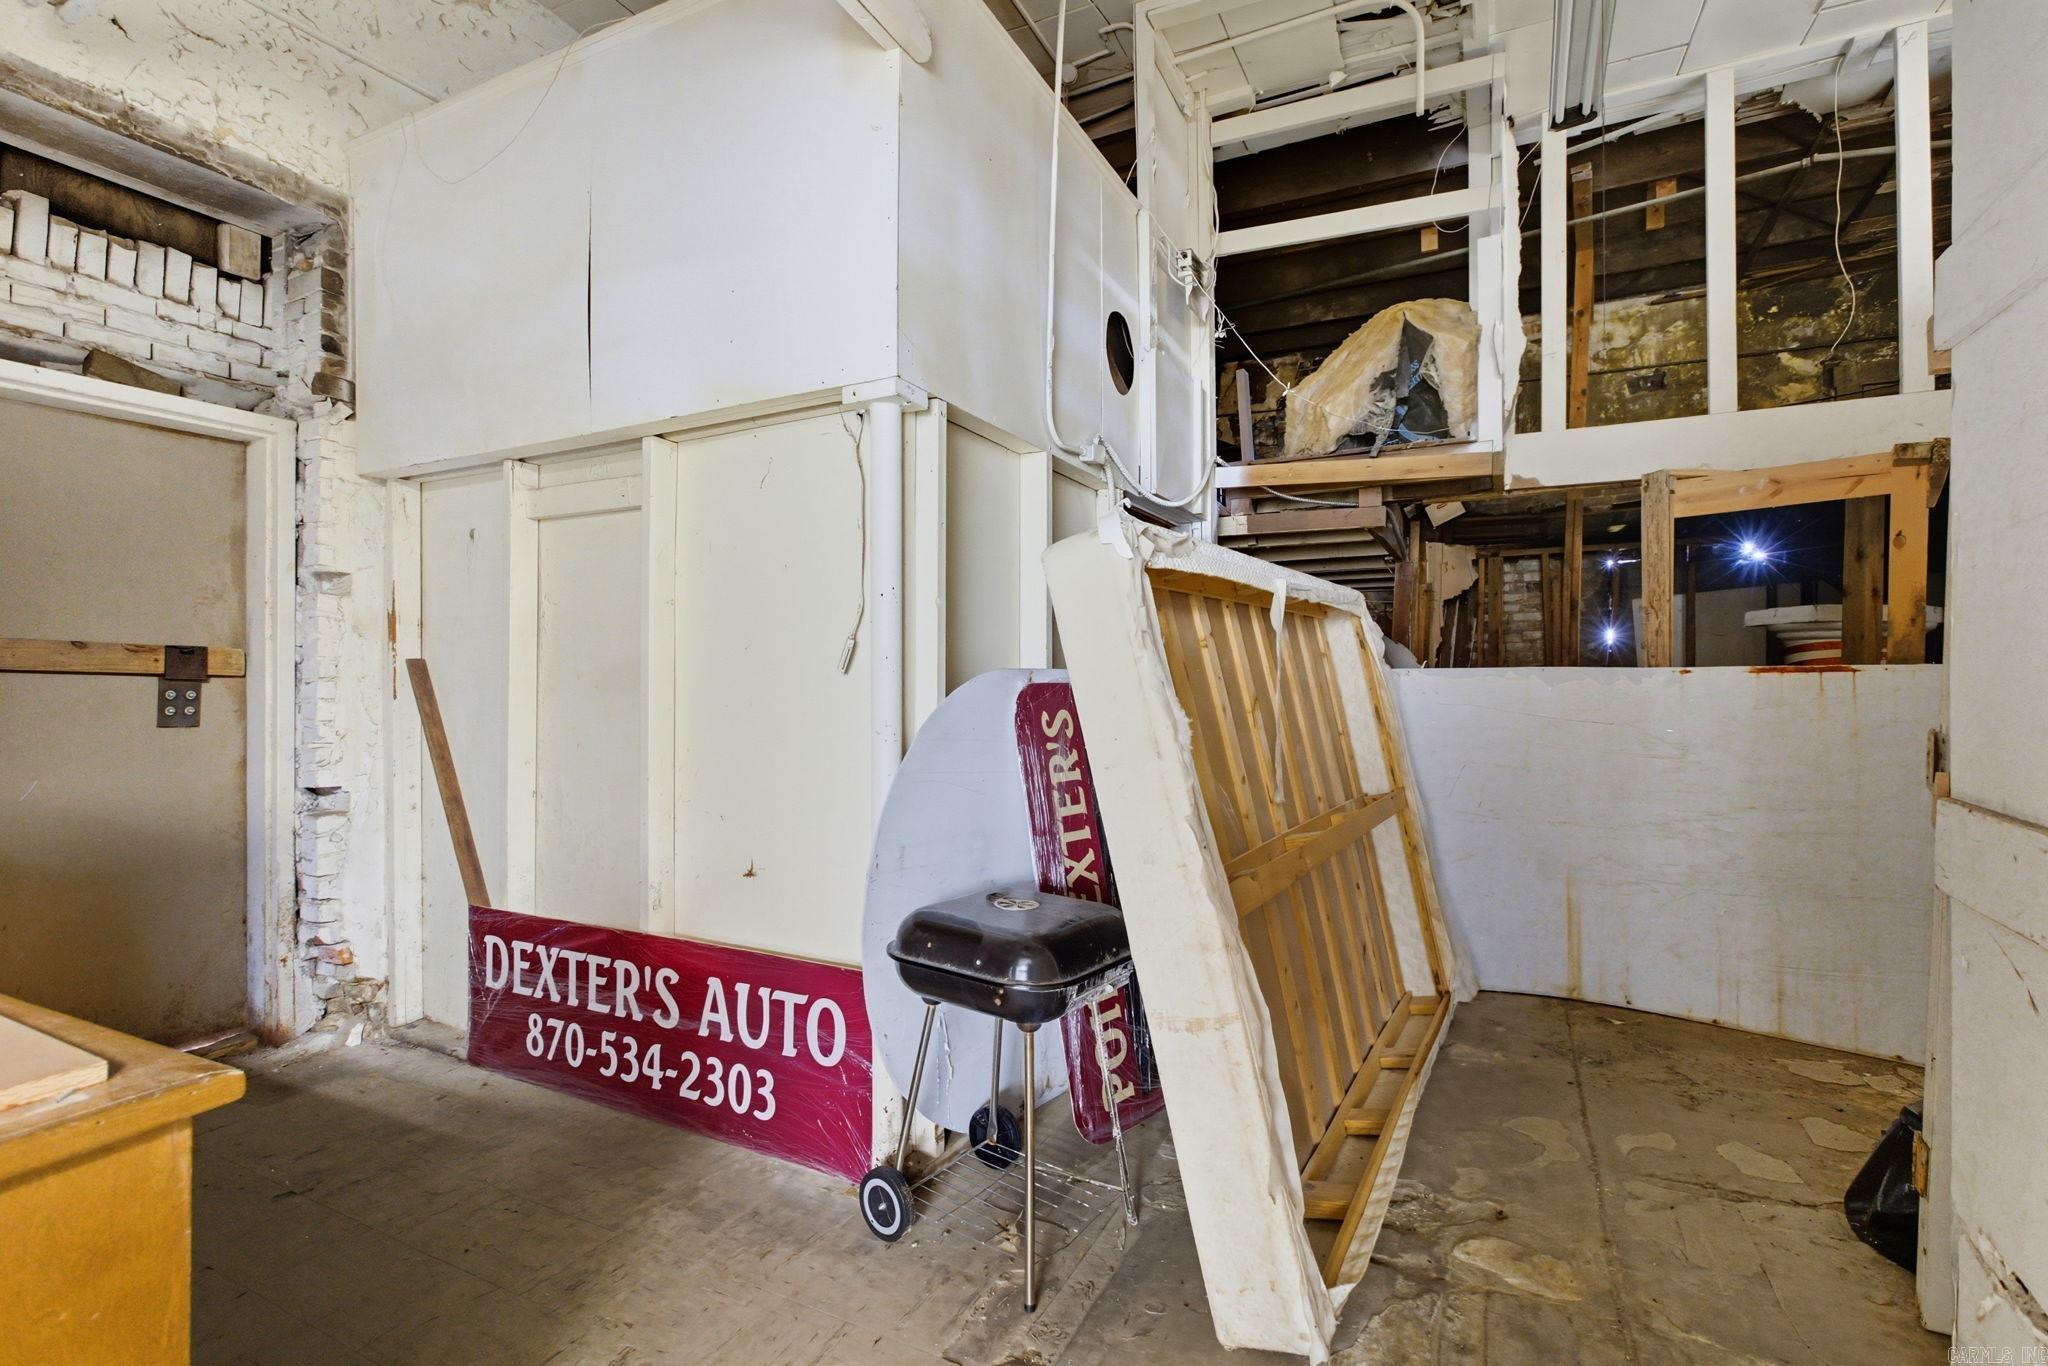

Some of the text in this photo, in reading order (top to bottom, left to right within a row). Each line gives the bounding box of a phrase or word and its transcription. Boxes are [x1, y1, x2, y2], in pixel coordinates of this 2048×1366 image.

[483, 934, 847, 1067] DEXTER'S AUTO
[525, 1013, 776, 1121] 870-534-2303
